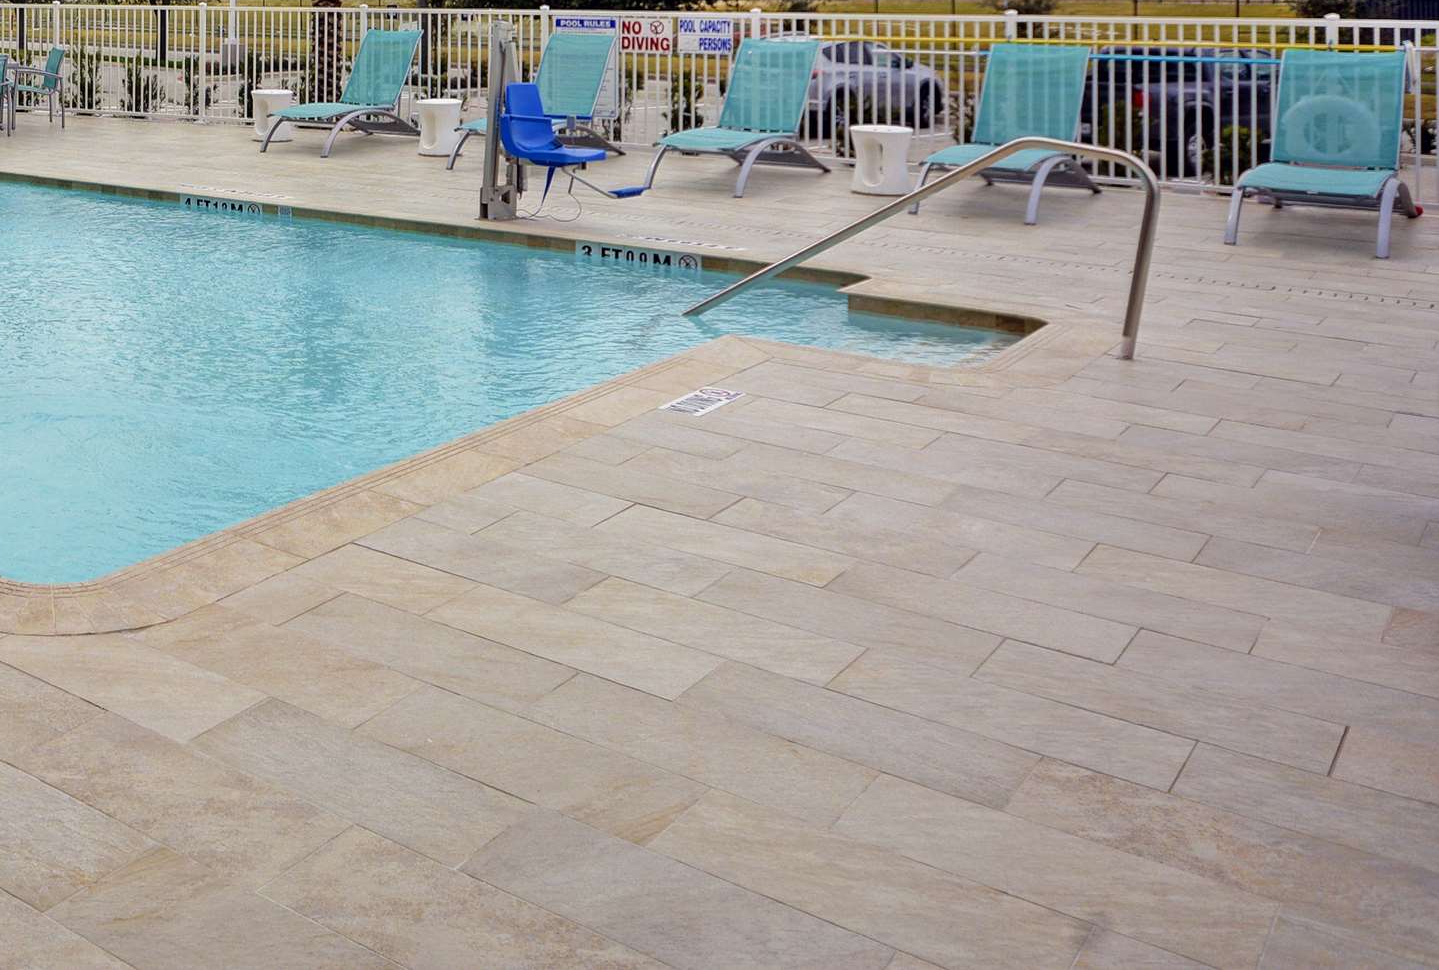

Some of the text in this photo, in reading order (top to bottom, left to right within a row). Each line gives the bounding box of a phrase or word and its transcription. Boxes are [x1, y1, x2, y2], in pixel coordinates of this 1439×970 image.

[560, 20, 611, 29] POOL RULES
[621, 20, 642, 35] NO
[679, 19, 730, 34] POOL CAPACITY
[621, 36, 670, 51] DIVING
[699, 37, 732, 52] PERSONS
